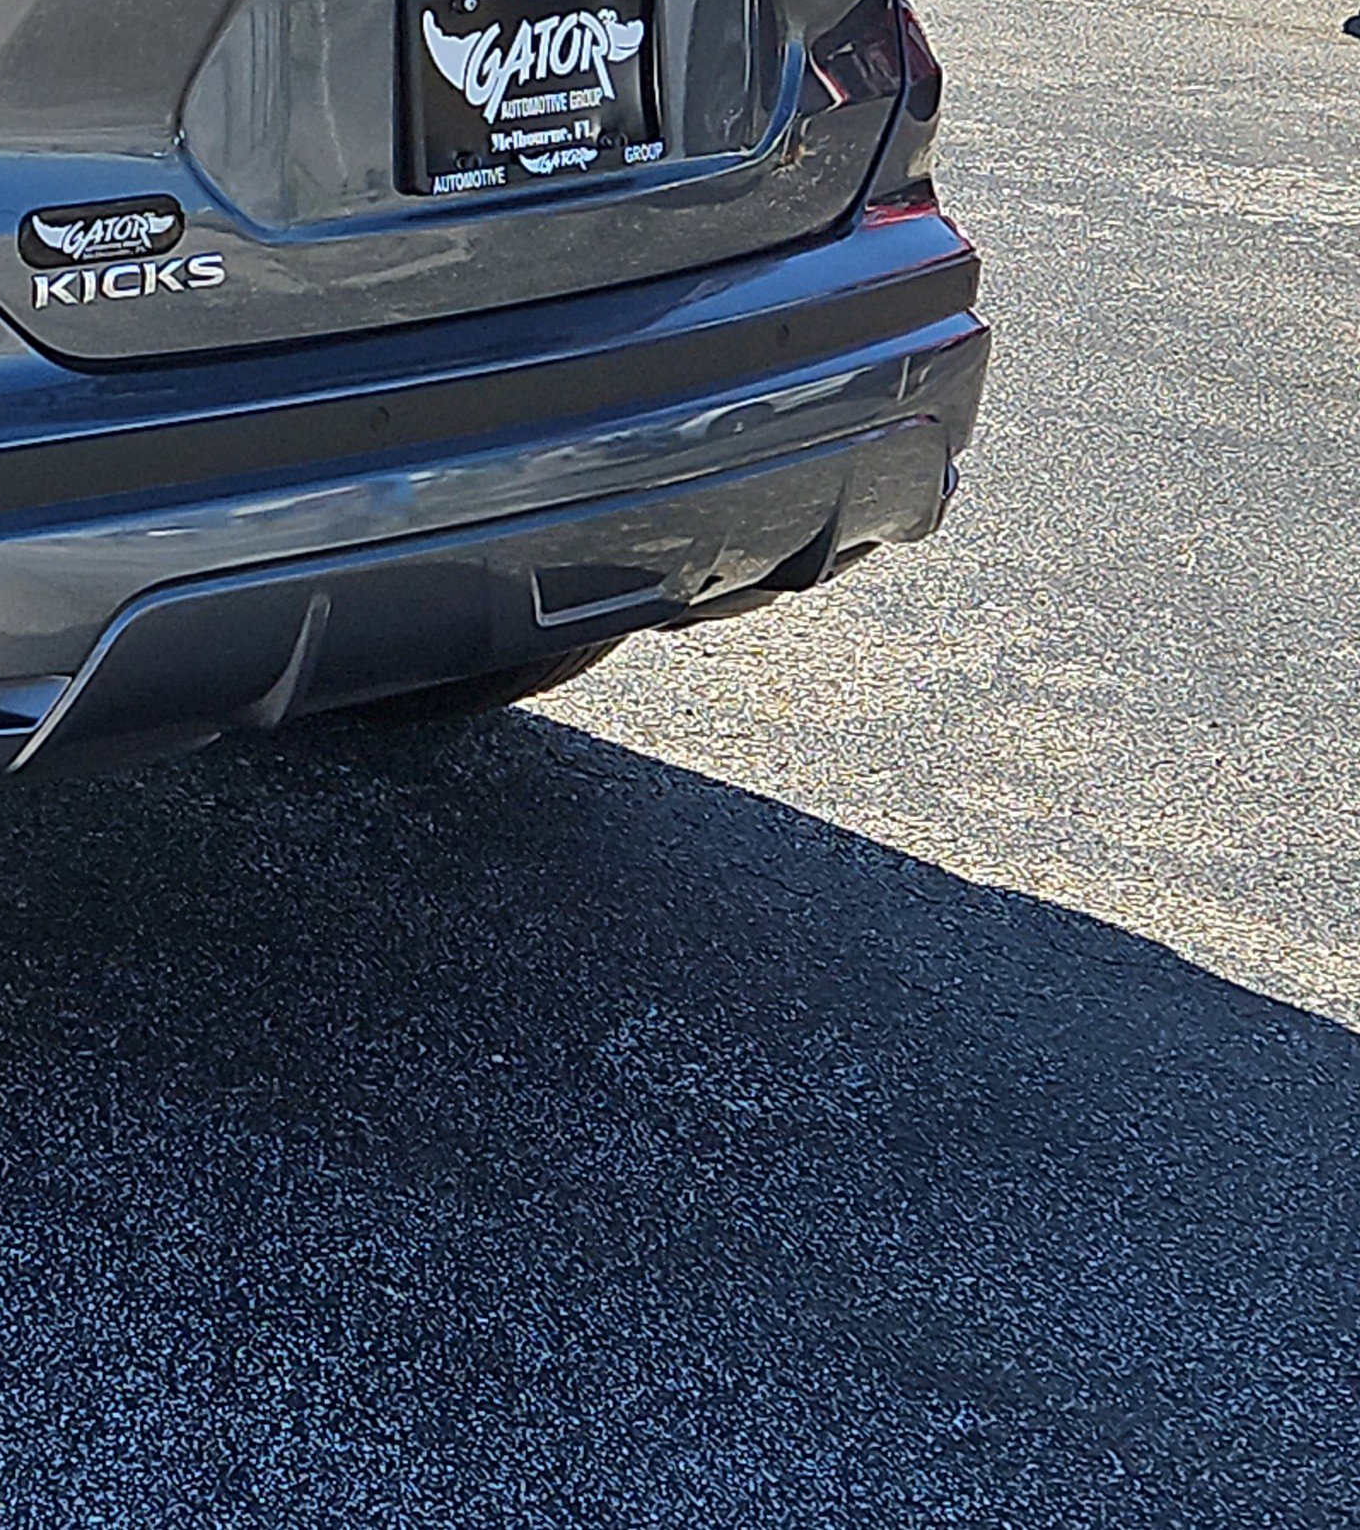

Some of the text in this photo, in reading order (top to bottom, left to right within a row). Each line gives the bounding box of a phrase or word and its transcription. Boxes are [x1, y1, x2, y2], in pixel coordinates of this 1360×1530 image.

[465, 11, 615, 124] GATOR
[500, 86, 603, 121] AUTOMOTIVE GROUP
[433, 166, 507, 195] AUTOMOTIVE
[624, 141, 664, 164] GROUP
[61, 213, 152, 260] GATOR
[34, 252, 226, 310] KICKS
